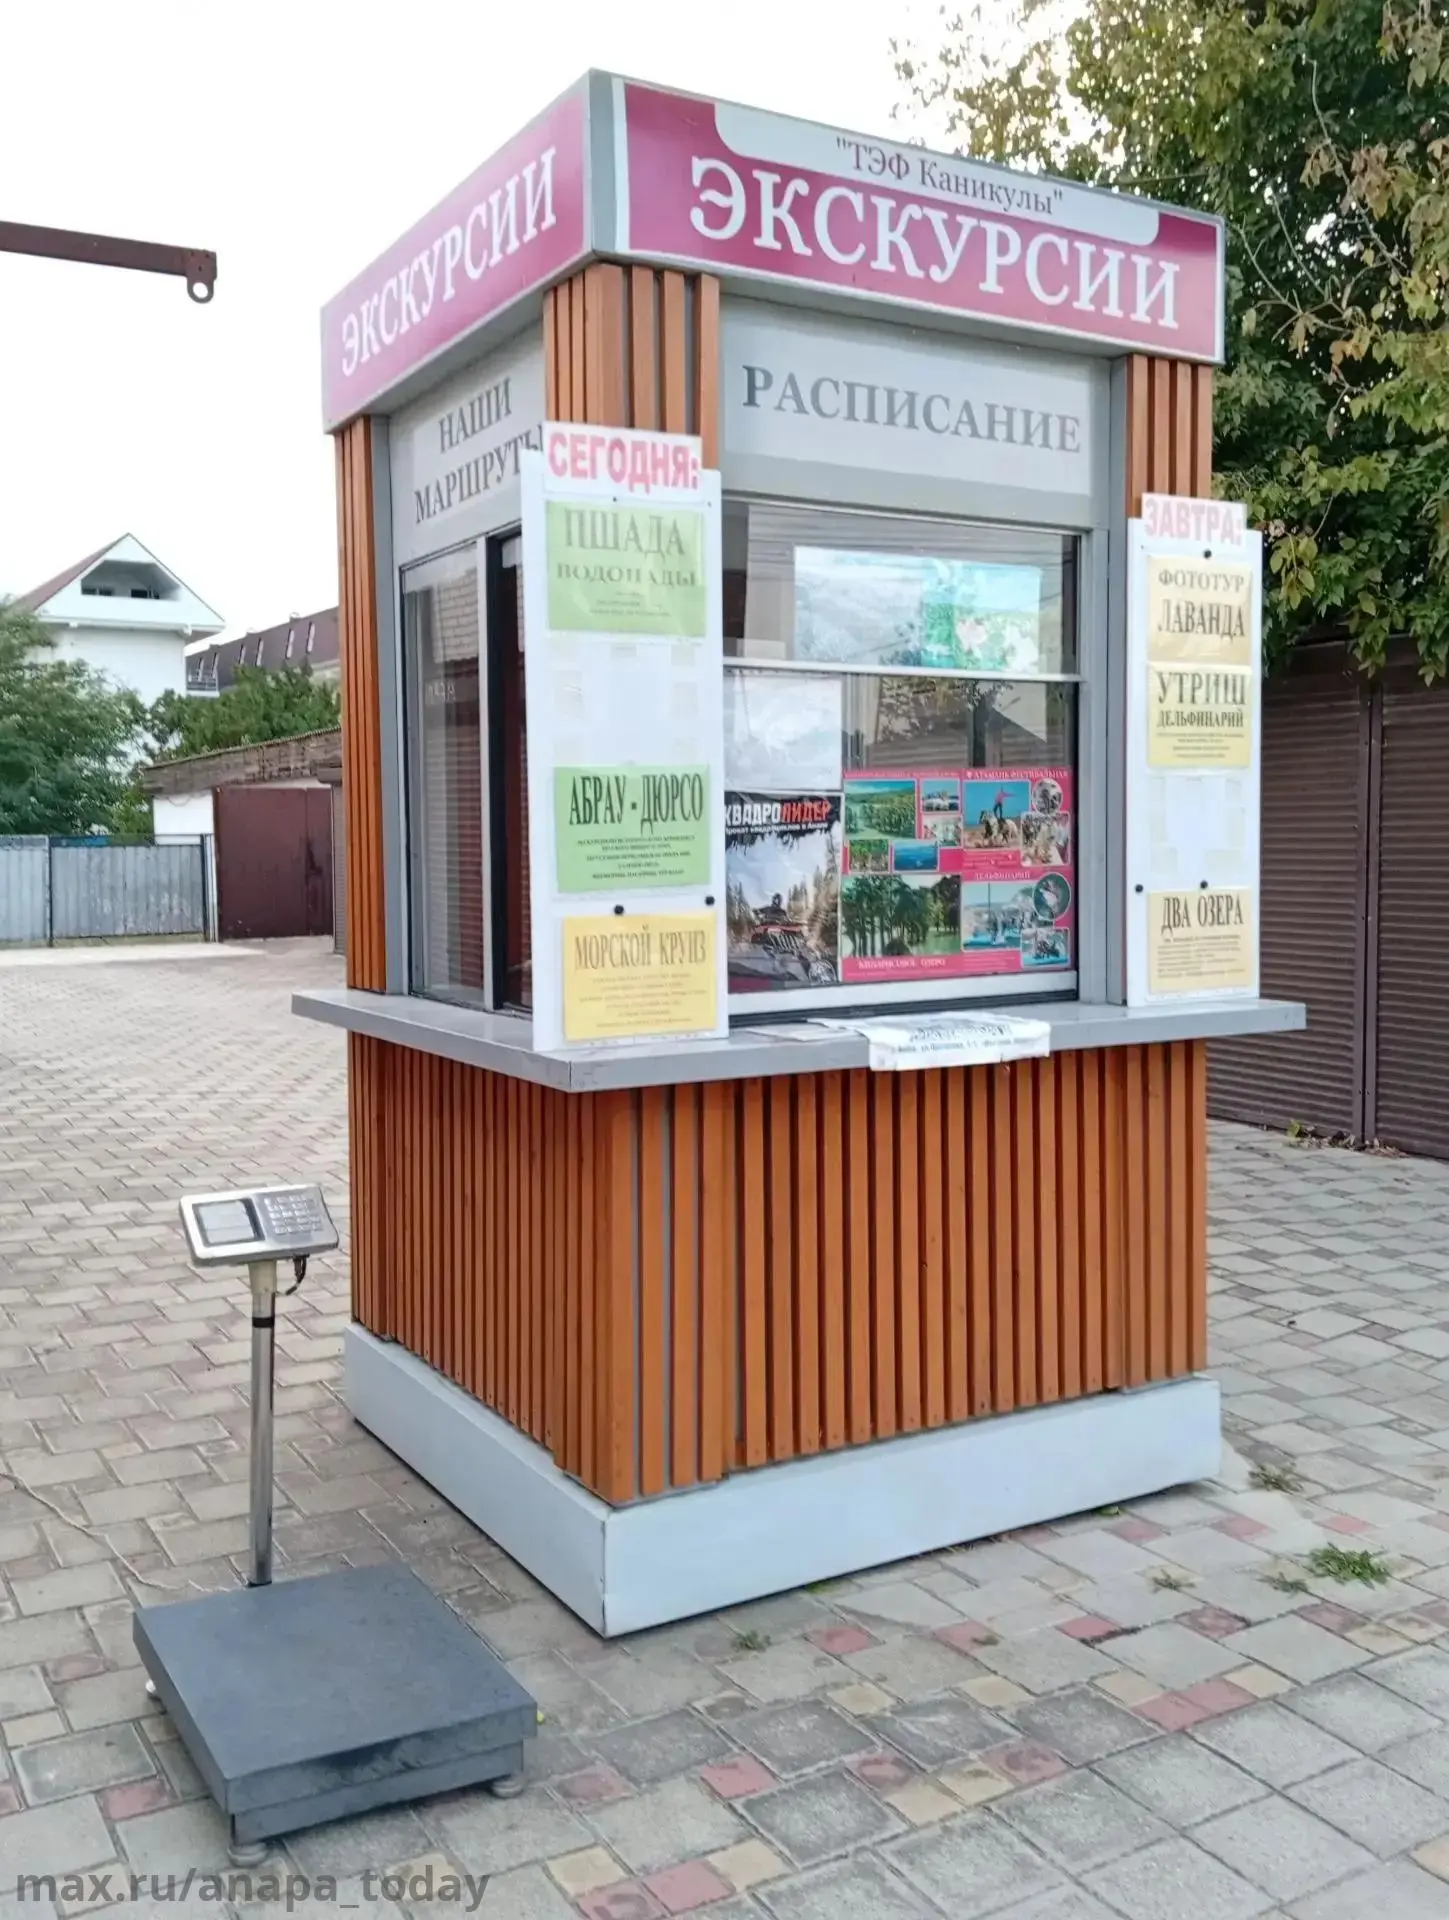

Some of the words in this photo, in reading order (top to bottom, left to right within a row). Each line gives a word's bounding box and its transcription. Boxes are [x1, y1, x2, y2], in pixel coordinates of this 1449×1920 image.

[836, 136, 911, 181] "ТЭФ
[918, 158, 1063, 216] Каникулы"
[341, 147, 556, 376] ЭКСКУРСИИ
[690, 155, 1180, 329] ЭКСКУРСИИ
[438, 376, 512, 455] НАШИ
[742, 364, 1082, 454] РАСПИСАНИЕ
[549, 431, 699, 494] СЕГОДНЯ:
[564, 507, 686, 561] ПШАДА
[1145, 497, 1243, 547] ЗАВТРА:
[1158, 568, 1245, 594] ФОТОТУР
[1157, 599, 1246, 640] ЛАВАНДА
[1157, 671, 1247, 706] УТРИШ
[1156, 709, 1245, 730] ДЕЛЬФИНАРИЙ
[1161, 897, 1191, 937] ДВА
[1197, 894, 1244, 927] ОЗЕРА
[574, 925, 652, 971] МОРСКОЙ
[658, 930, 706, 966] КРУИЗ
